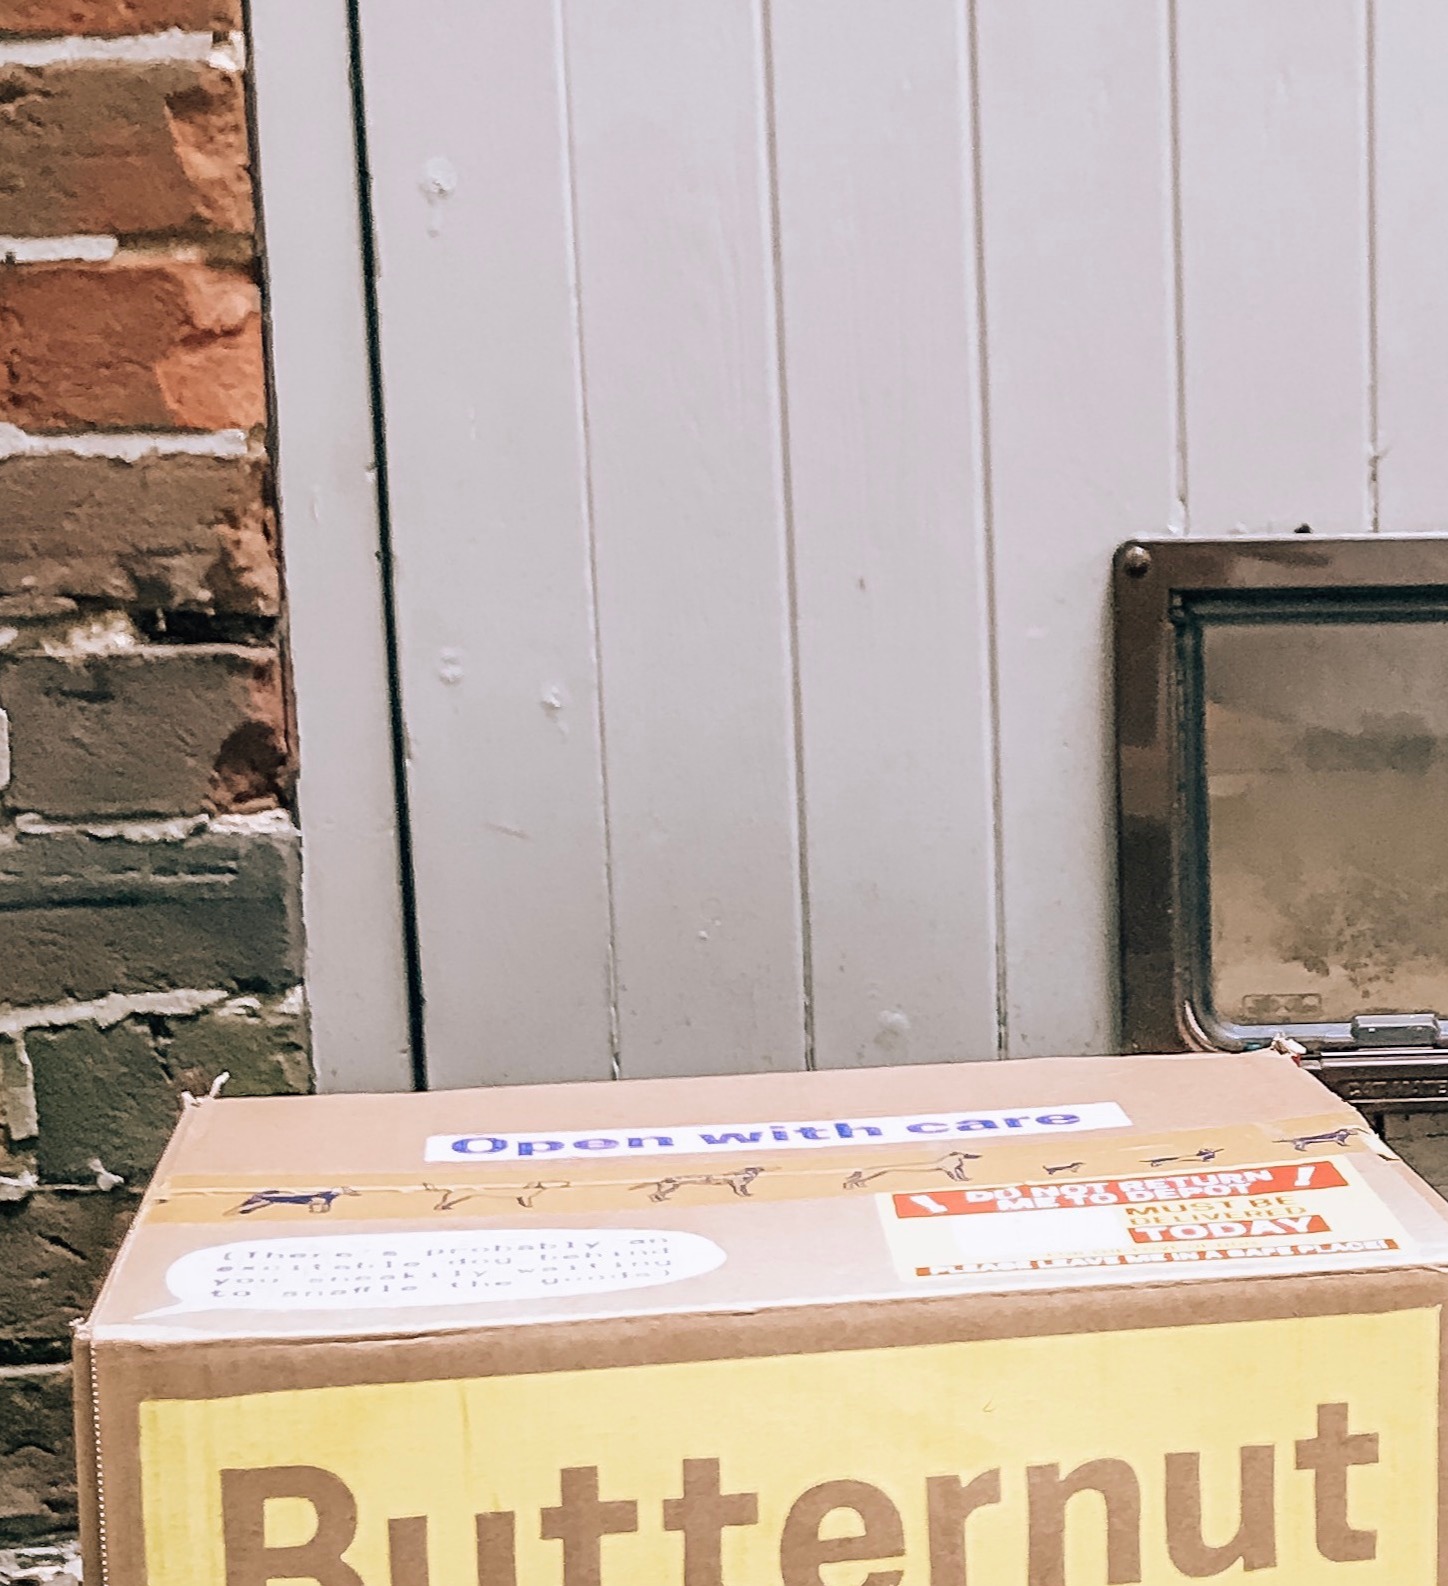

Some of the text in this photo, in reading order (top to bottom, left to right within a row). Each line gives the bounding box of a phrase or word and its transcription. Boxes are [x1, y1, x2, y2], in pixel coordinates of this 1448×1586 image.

[451, 1112, 1081, 1157] Open with care
[965, 1186, 1021, 1203] DO
[1032, 1180, 1109, 1198] NOT
[1117, 1169, 1273, 1193] RETURN
[997, 1182, 1252, 1211] ME TO DEPOT
[1125, 1195, 1295, 1216] MUST BE
[1130, 1206, 1307, 1226] DELIVERED
[1135, 1216, 1313, 1243] TODAY
[1037, 1254, 1119, 1269] LEAVE
[1125, 1252, 1165, 1265] ME
[1172, 1250, 1200, 1262] IN
[1204, 1249, 1225, 1261] A
[1227, 1245, 1292, 1258] SAFE
[211, 1289, 251, 1298] to
[220, 1402, 1379, 1586] Butternut
